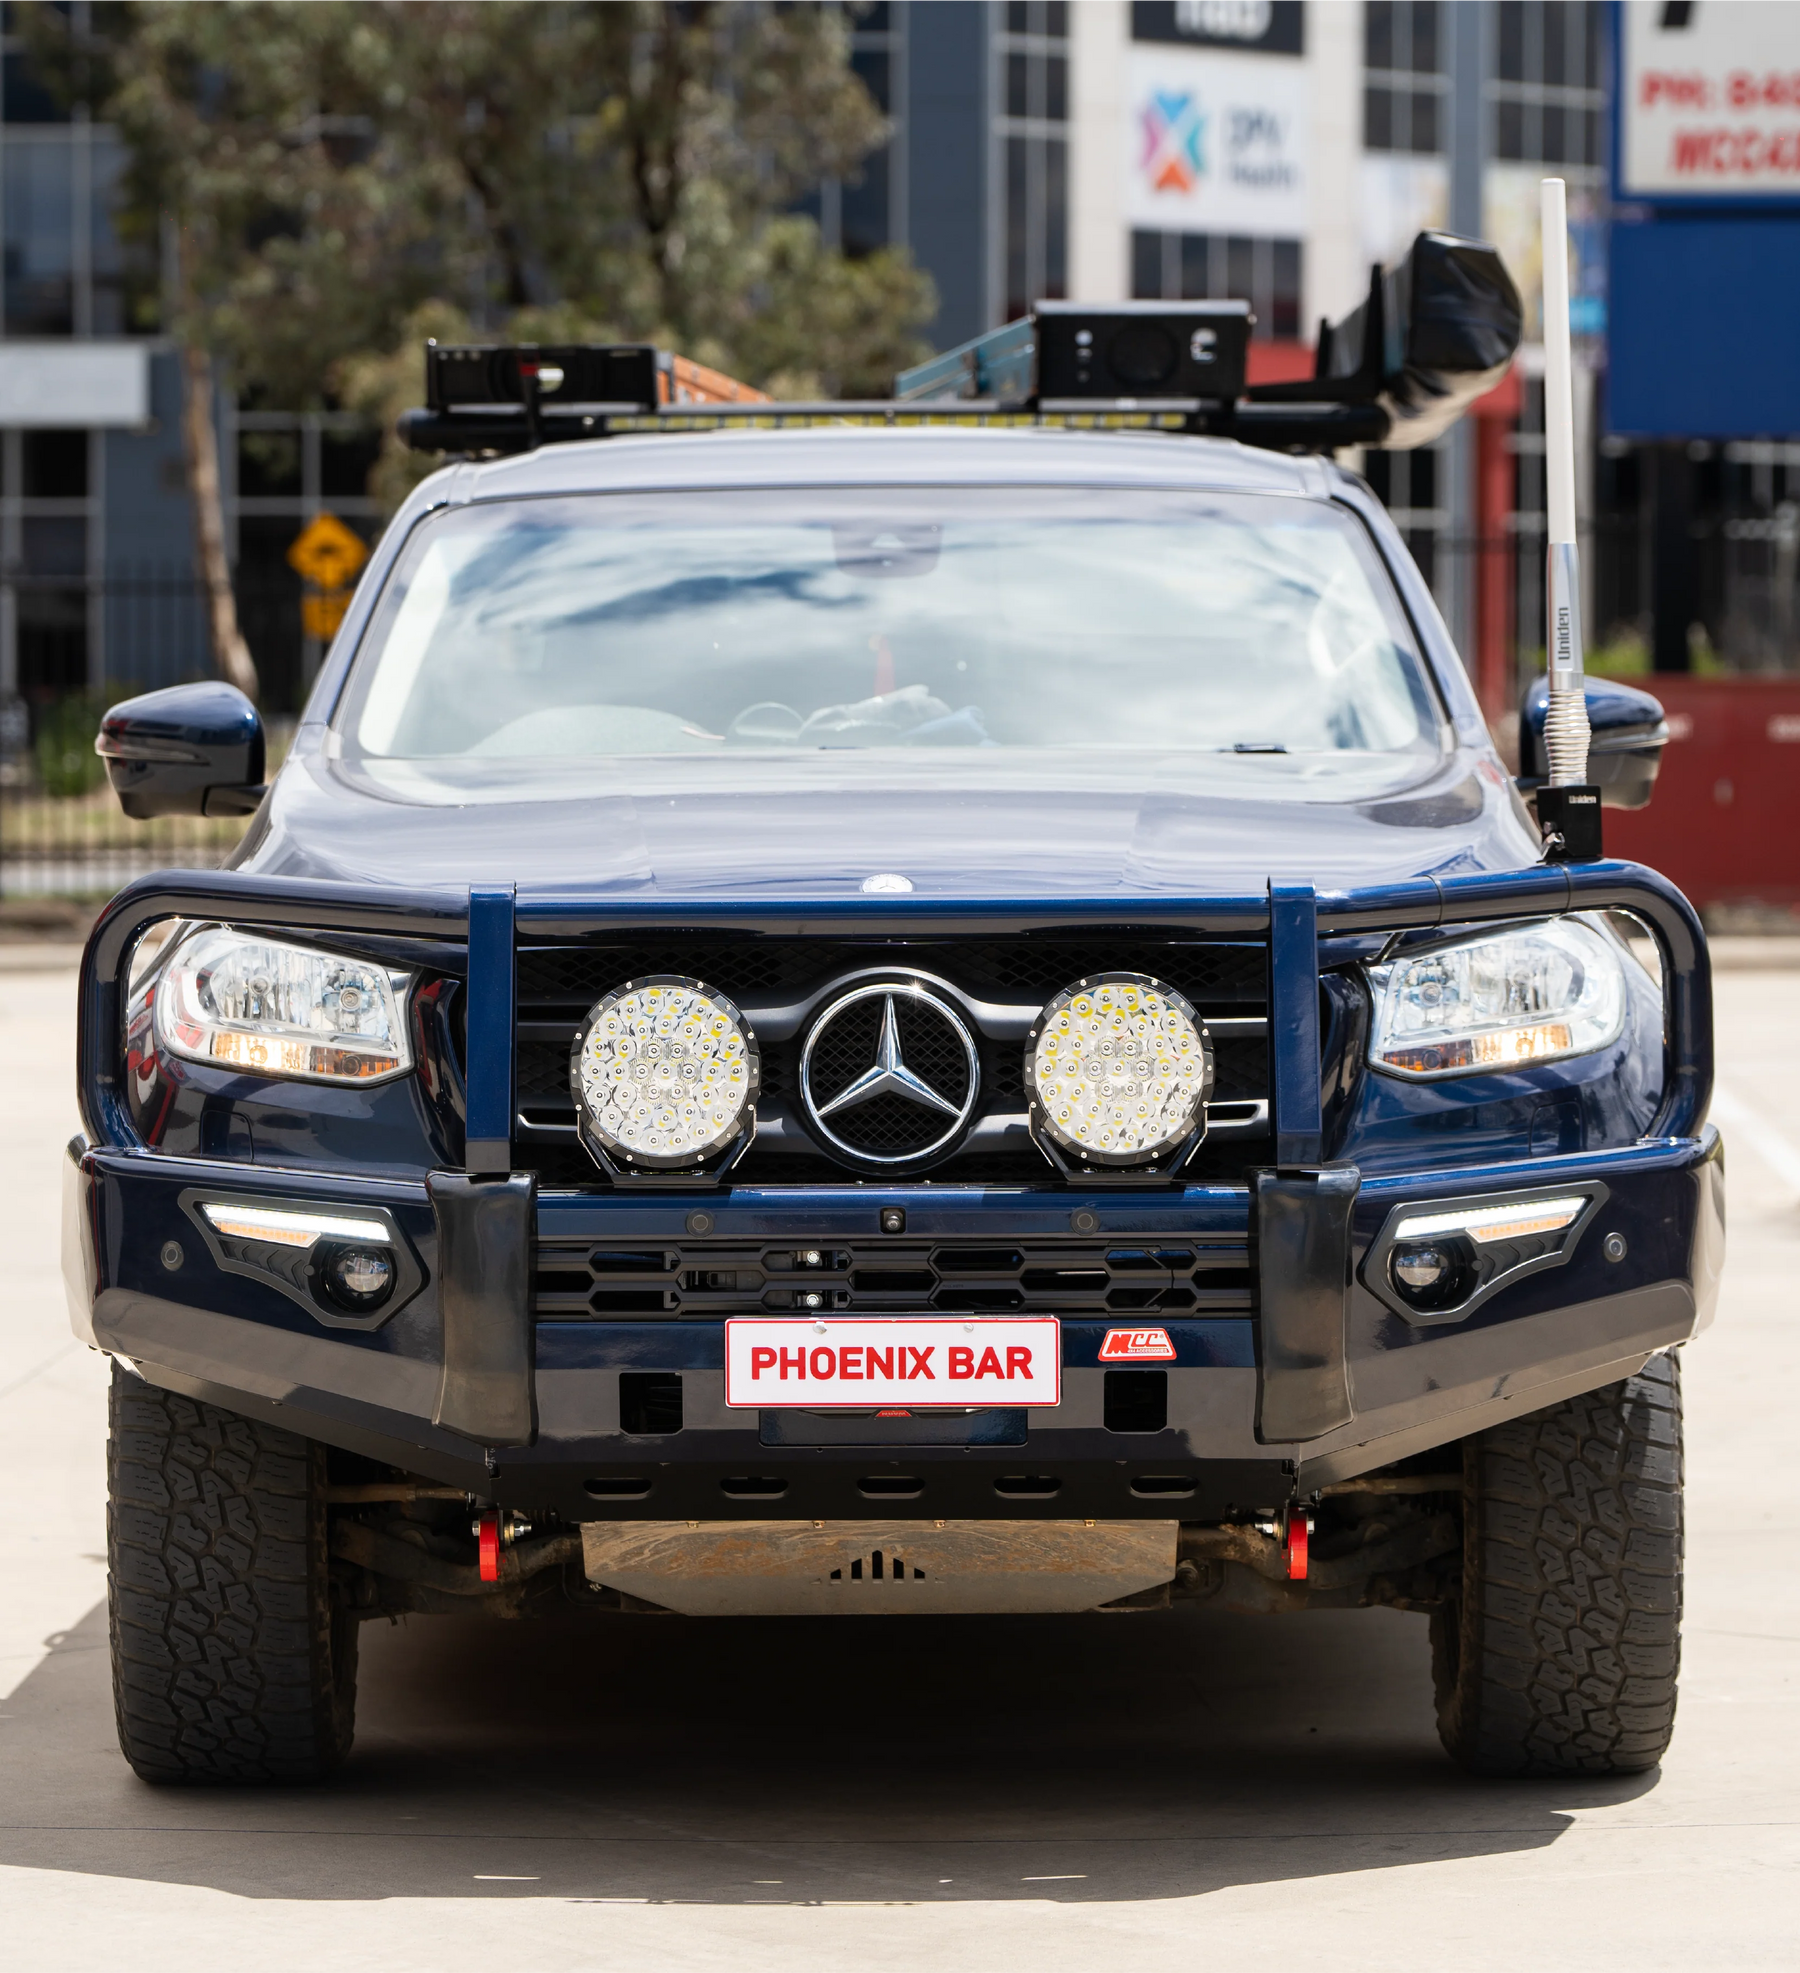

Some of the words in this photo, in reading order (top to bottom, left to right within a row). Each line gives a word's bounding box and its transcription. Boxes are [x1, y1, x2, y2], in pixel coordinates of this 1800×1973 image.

[1557, 607, 1570, 660] Uniden
[1568, 794, 1597, 804] Uniden
[1105, 1333, 1168, 1354] MCC
[751, 1346, 936, 1380] PHOENIX
[948, 1346, 1034, 1380] BAR
